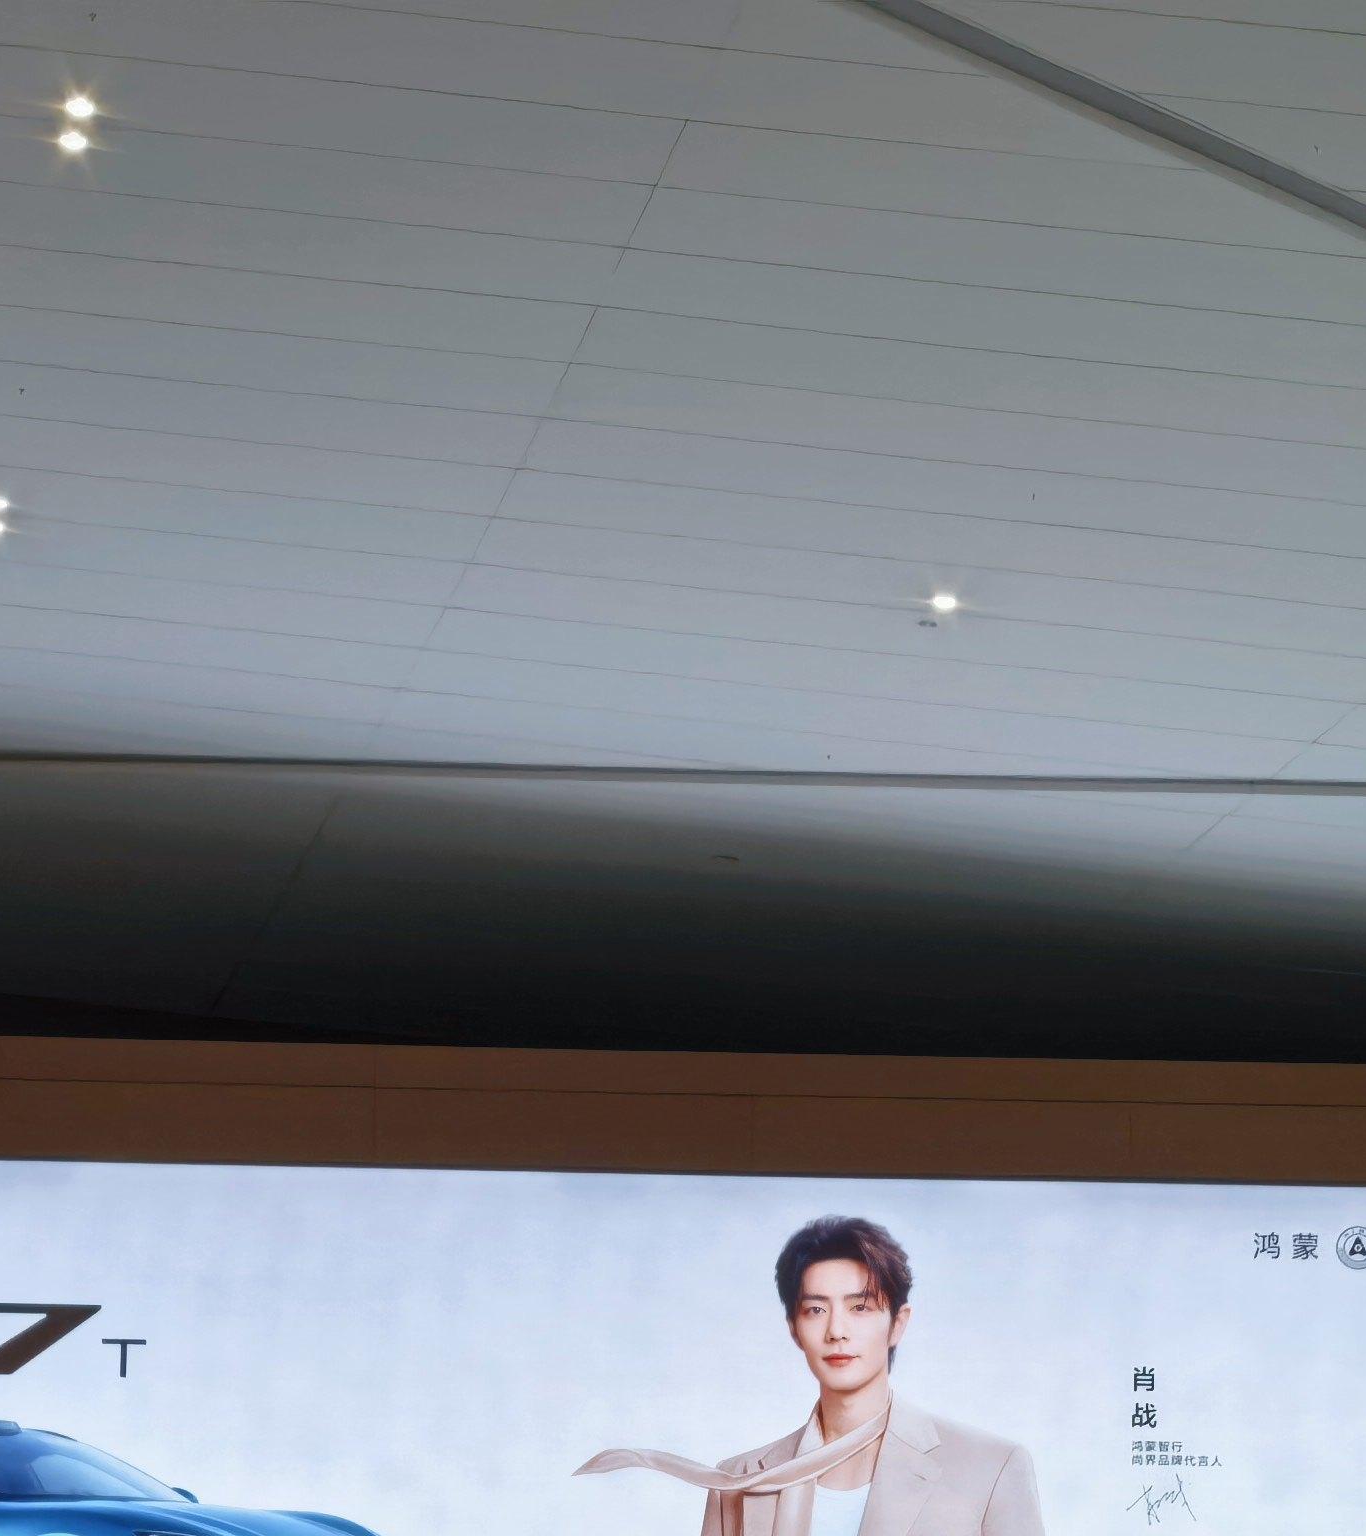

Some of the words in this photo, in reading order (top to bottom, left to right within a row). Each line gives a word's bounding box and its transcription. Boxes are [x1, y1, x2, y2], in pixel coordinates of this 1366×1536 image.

[1253, 1231, 1319, 1260] 鸿蒙
[1131, 1366, 1157, 1429] 肖战
[1131, 1454, 1223, 1467] 尚界品牌代言人
